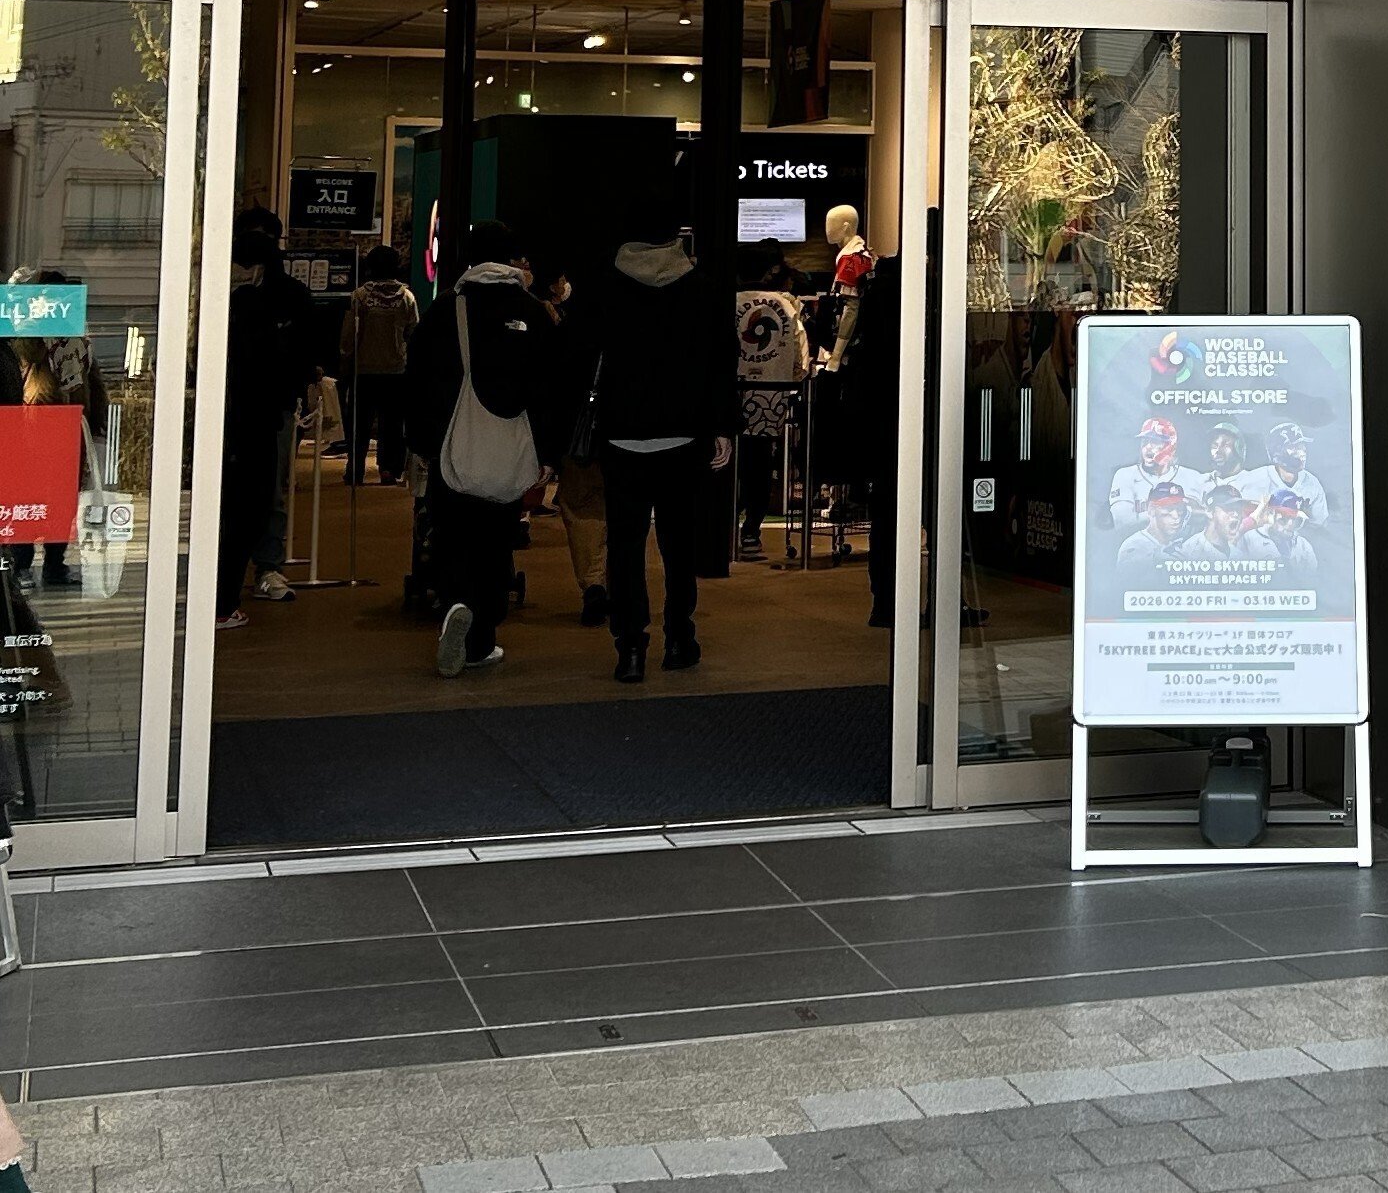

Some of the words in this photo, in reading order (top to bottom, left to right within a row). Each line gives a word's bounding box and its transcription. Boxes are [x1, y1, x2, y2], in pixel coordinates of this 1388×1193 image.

[753, 159, 829, 179] Tickets
[317, 189, 348, 204] 入口
[306, 205, 357, 215] ENTRANCE
[1204, 338, 1265, 351] WORLD
[1204, 350, 1289, 364] BASEBALL
[1204, 364, 1275, 377] CLASSIC
[1150, 390, 1229, 405] OFFICIAL
[1231, 389, 1288, 404] STORE
[1168, 574, 1219, 585] SKYTREE
[1221, 574, 1258, 585] SPACE
[1206, 595, 1227, 606] FRI
[1279, 595, 1311, 606] WED
